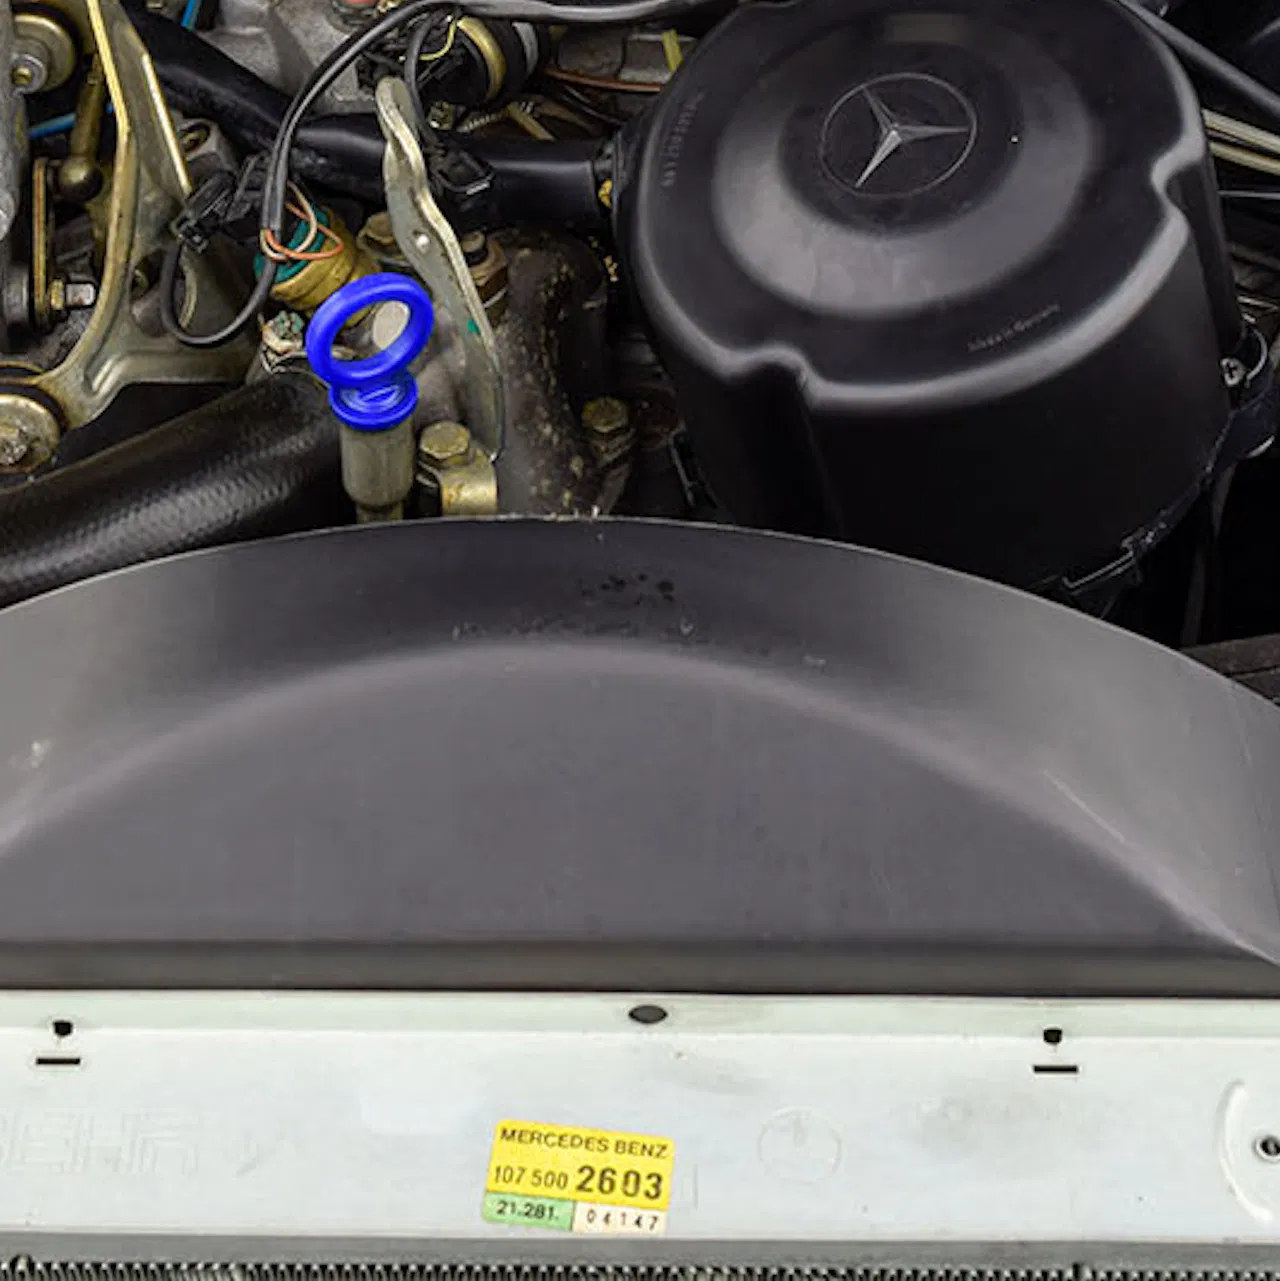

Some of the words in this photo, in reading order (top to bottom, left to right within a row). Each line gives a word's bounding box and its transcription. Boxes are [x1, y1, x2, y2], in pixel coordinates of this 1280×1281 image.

[500, 1127, 610, 1153] MERCEDES
[614, 1138, 669, 1159] BENZ
[494, 1164, 527, 1186] 107
[531, 1169, 569, 1190] 500
[575, 1164, 663, 1201] 2603
